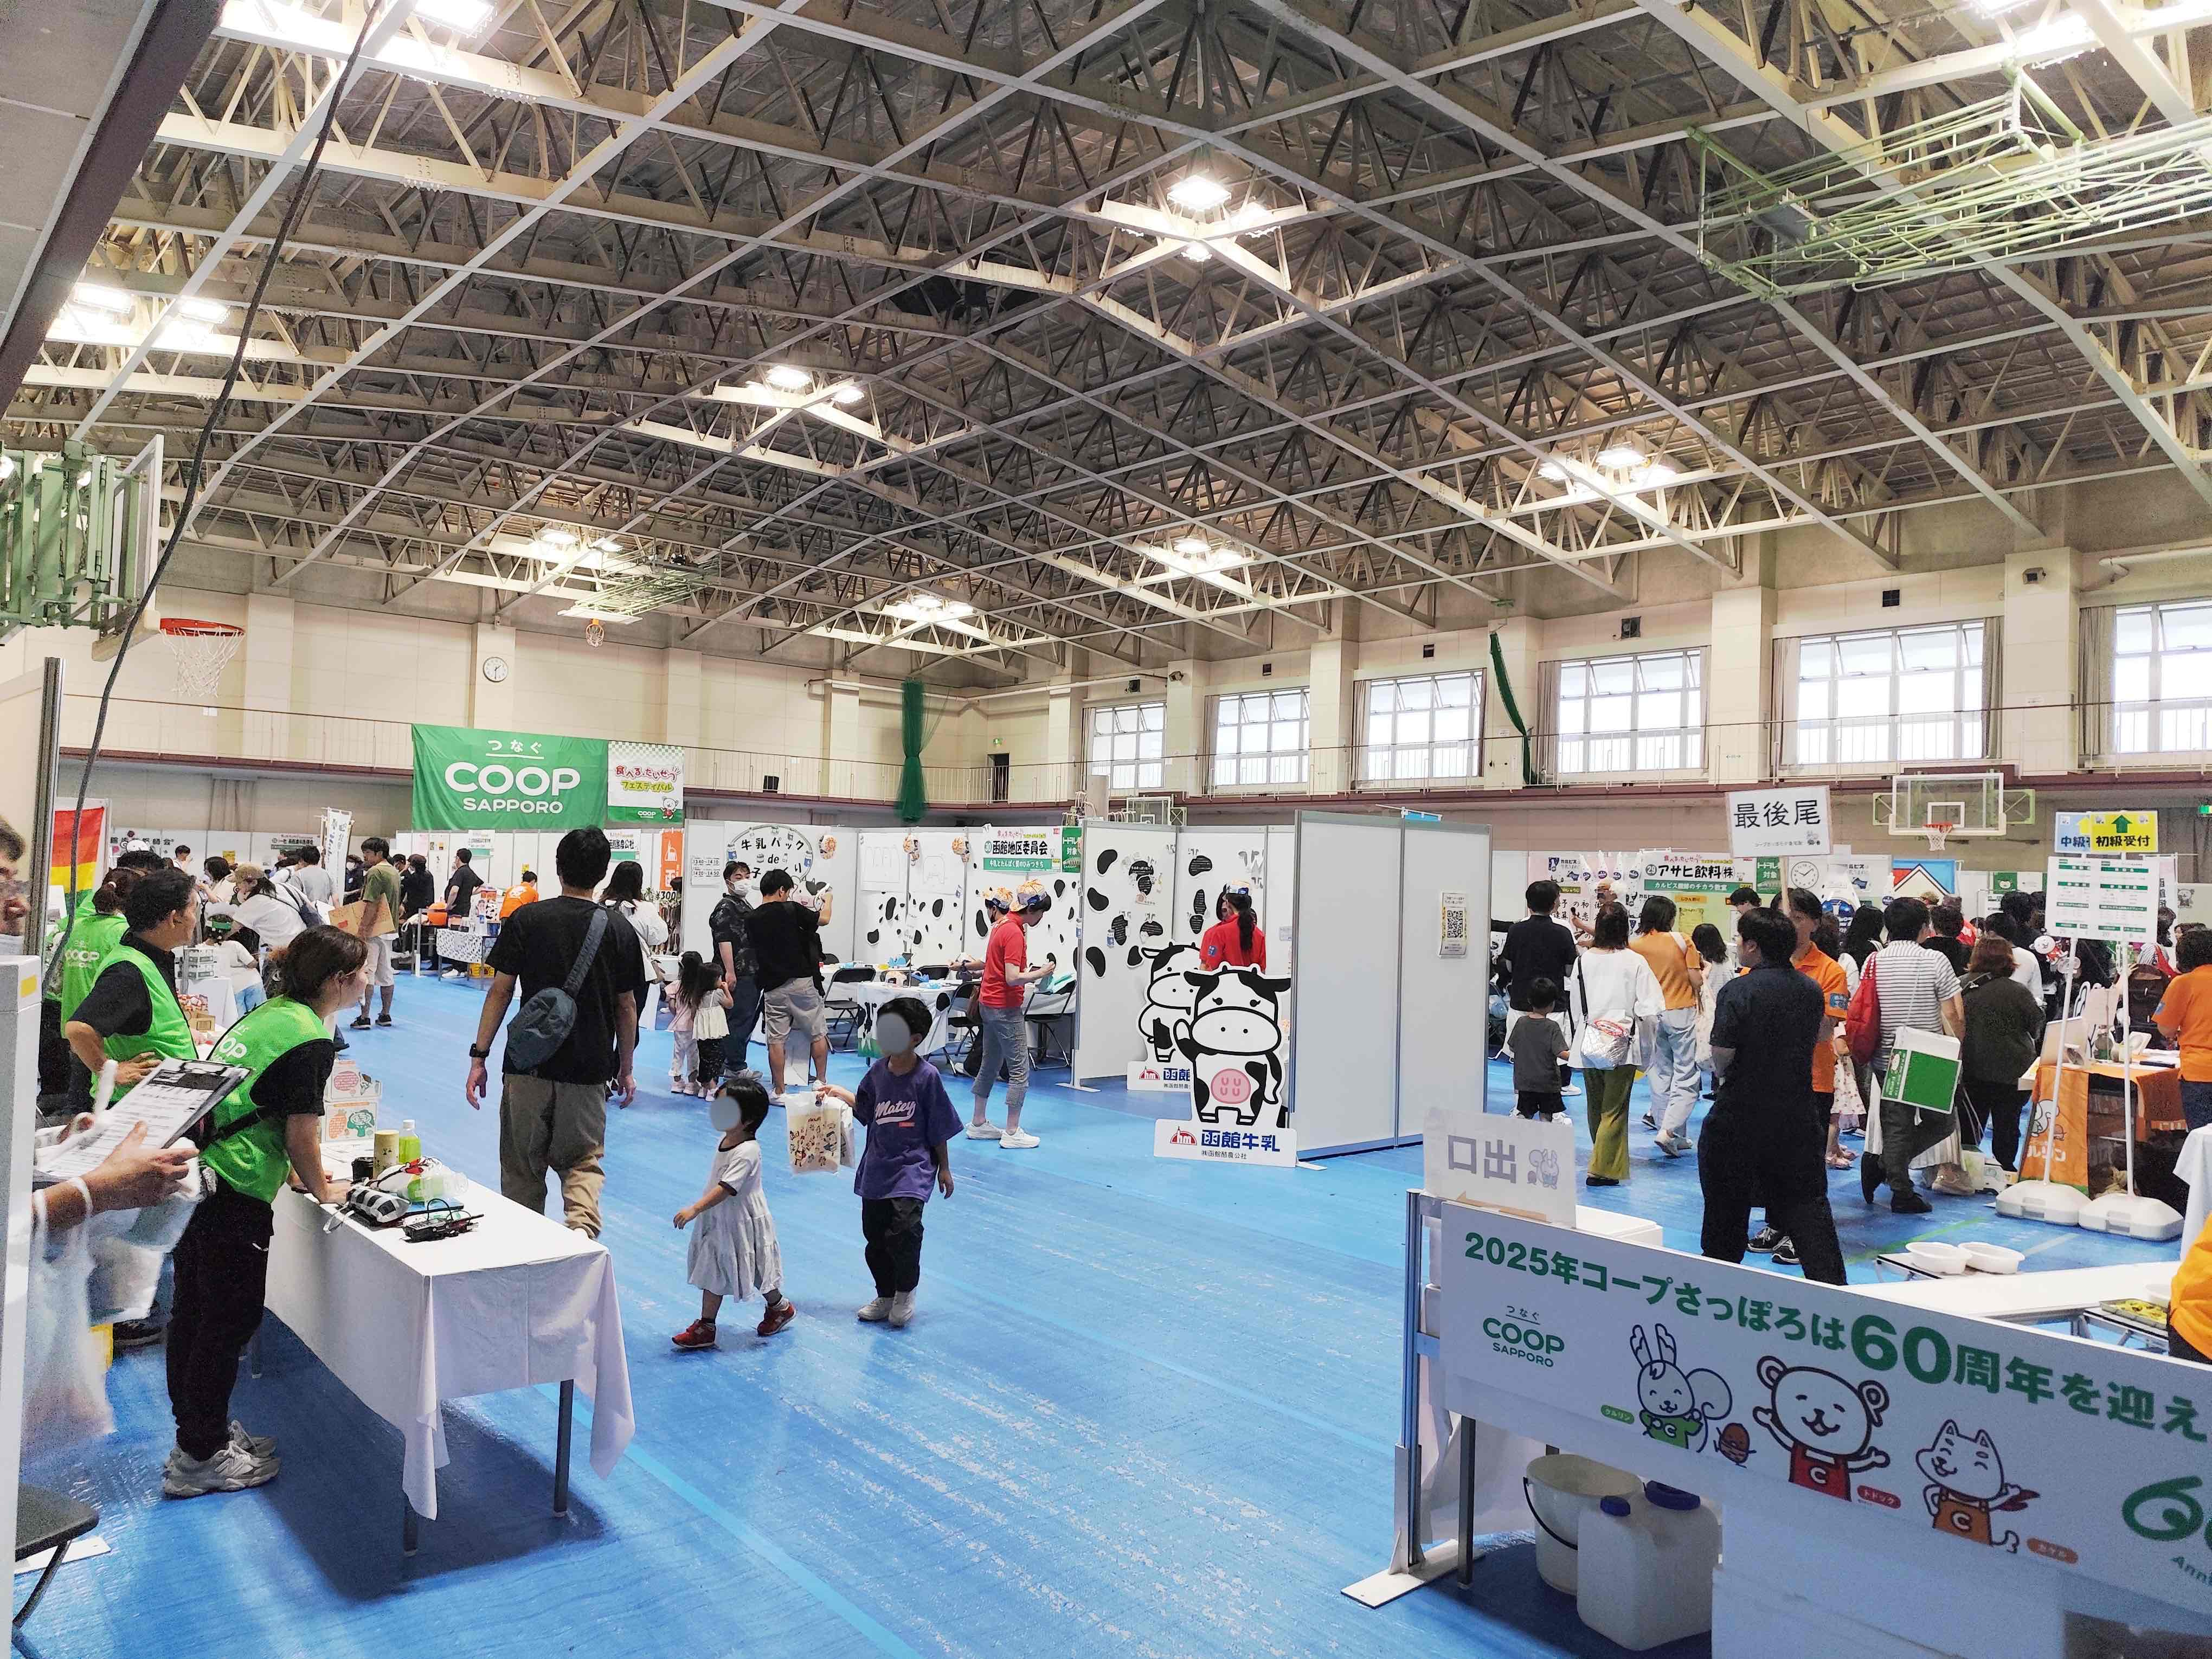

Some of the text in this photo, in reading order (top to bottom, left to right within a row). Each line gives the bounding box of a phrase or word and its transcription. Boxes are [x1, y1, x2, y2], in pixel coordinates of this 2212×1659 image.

[487, 739, 542, 754] つなぐ
[445, 761, 581, 796] COOP
[463, 798, 564, 814] SAPPORO
[1733, 800, 1821, 829] 最後尾
[993, 840, 1048, 856] 函館地区委員会
[2096, 835, 2151, 847] 初級受付
[767, 854, 779, 864] de
[1163, 1068, 1191, 1082] 函館
[875, 1100, 916, 1121] Matey
[1201, 1129, 1281, 1152] 函館牛乳
[1506, 1305, 1540, 1321] つなぐ
[1483, 1317, 1565, 1354] COOP
[1492, 1342, 1554, 1368] SAPPORO
[2121, 1475, 2212, 1552] 6
